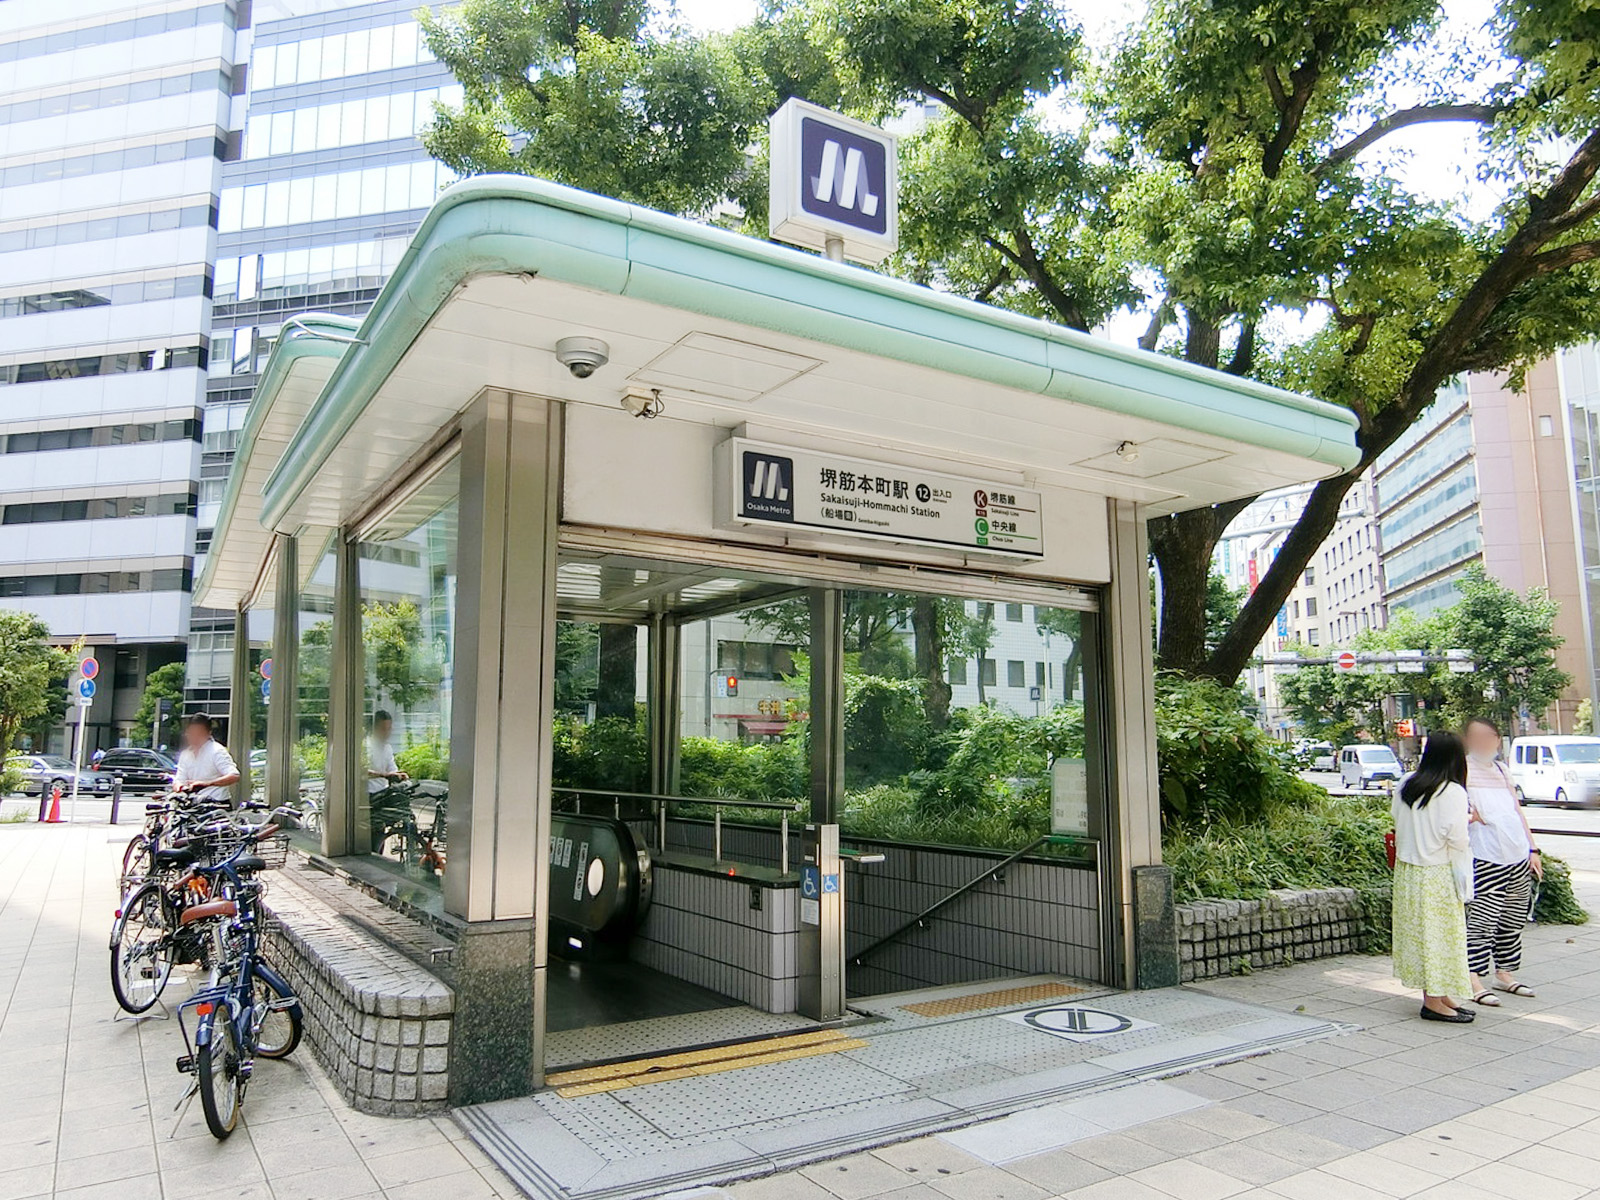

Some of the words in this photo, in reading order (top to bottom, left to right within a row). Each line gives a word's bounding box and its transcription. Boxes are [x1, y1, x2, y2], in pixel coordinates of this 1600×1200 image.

[820, 467, 909, 500] 堺筋本町駅
[932, 488, 952, 499] 出入口
[746, 502, 769, 513] Osaka
[769, 505, 791, 515] Metro
[820, 492, 908, 514] Sakaisuji-Hommachi
[911, 505, 940, 519] Station
[991, 520, 1017, 533] 中央線
